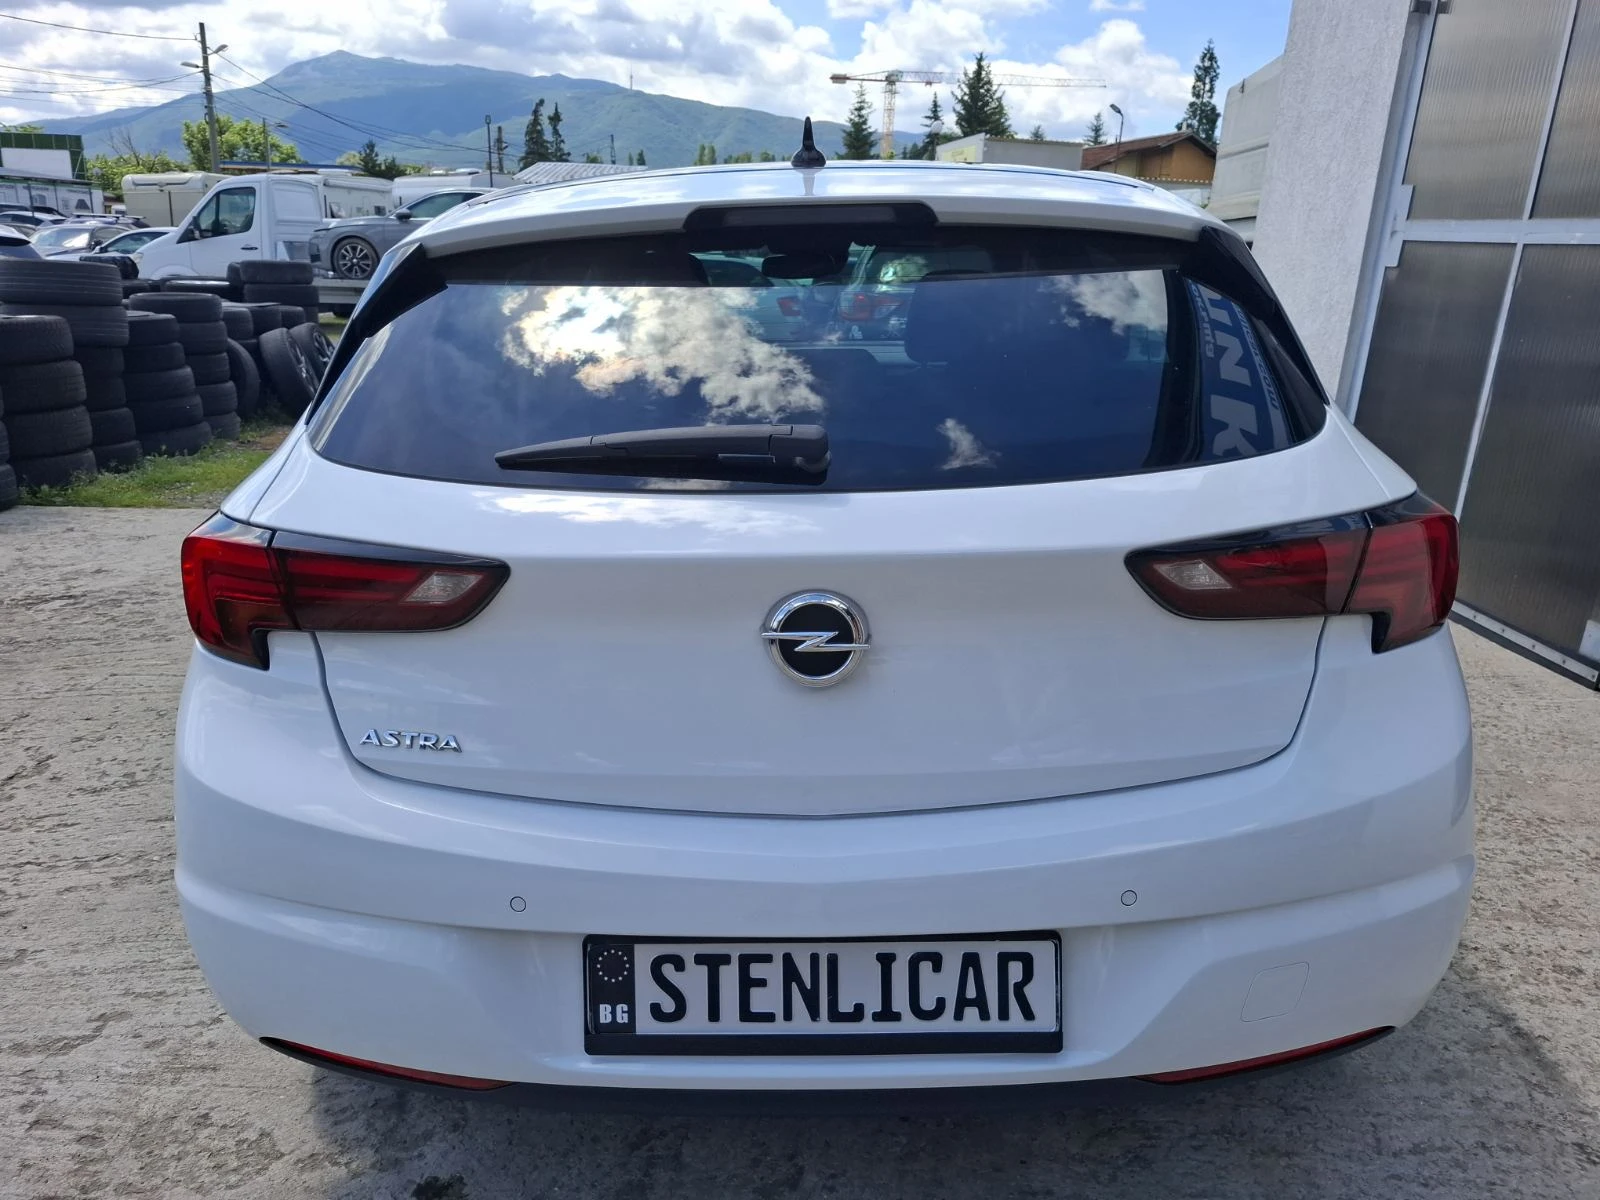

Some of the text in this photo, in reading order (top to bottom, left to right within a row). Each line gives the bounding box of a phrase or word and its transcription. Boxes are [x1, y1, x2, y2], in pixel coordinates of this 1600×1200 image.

[360, 729, 462, 753] ASTRA
[649, 951, 1035, 1023] STENLICAR
[599, 1003, 629, 1024] BG
